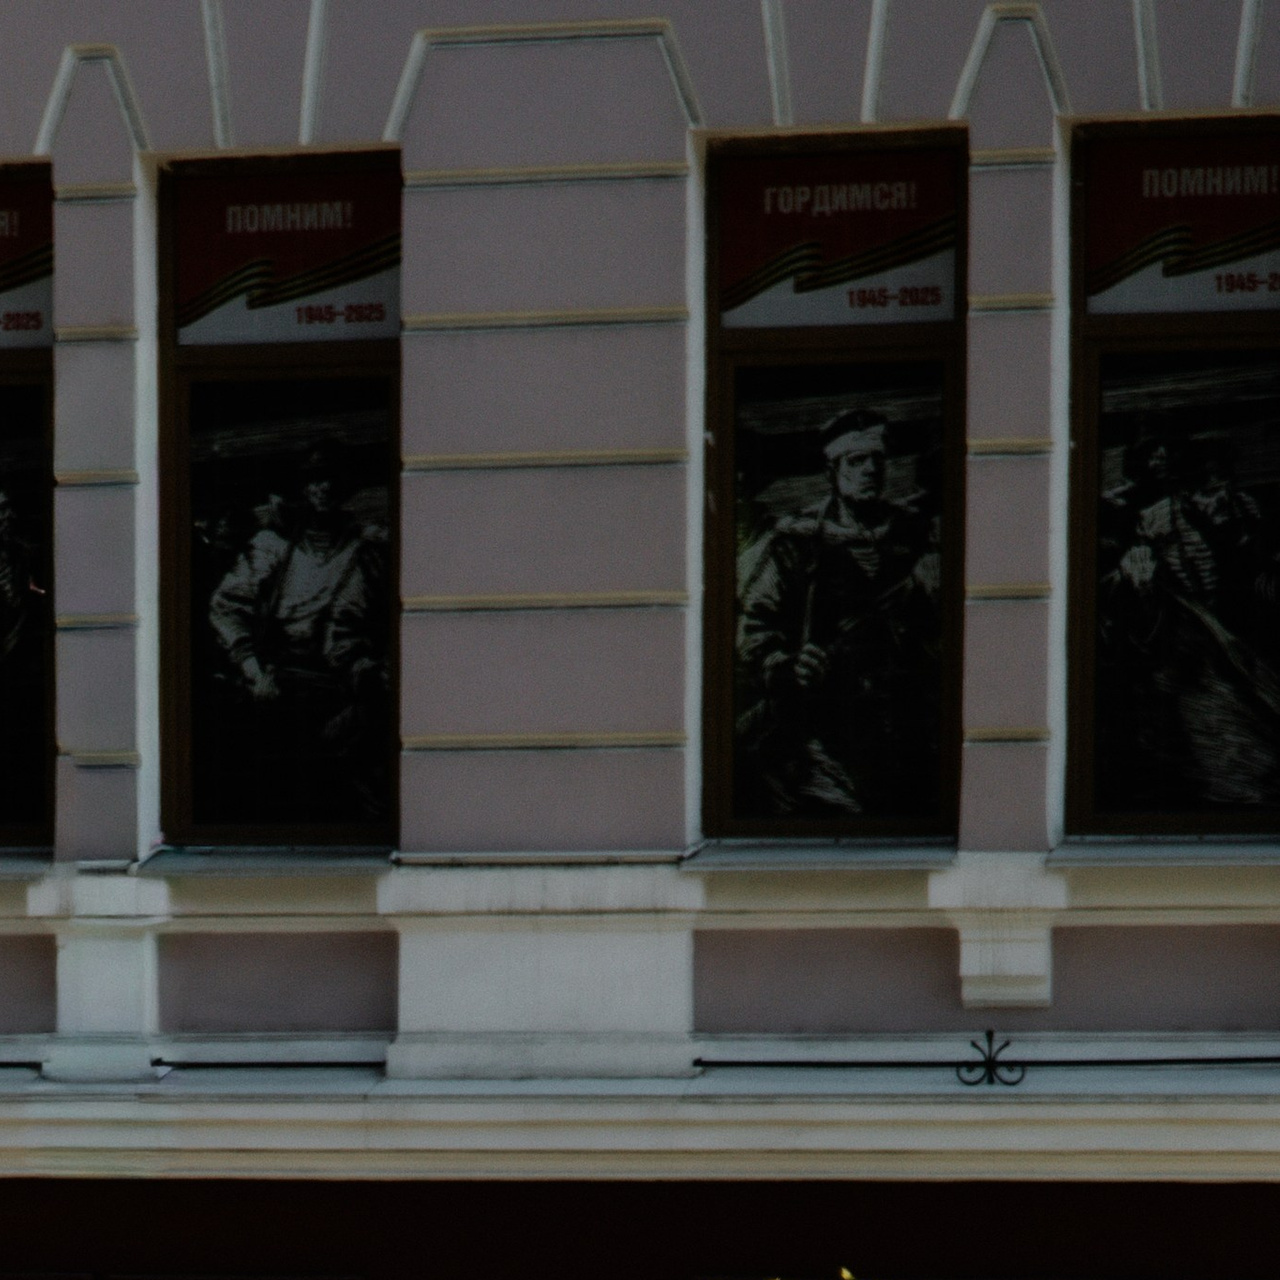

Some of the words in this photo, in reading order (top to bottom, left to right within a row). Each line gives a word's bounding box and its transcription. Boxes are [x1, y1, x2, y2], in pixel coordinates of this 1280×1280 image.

[1142, 165, 1279, 198] ПОМНИМ!
[764, 183, 917, 217] ГОРДИМСЯ!
[226, 202, 352, 234] ПОМНИМ!
[1215, 272, 1280, 294] 1945-2
[848, 287, 941, 309] 1945-2025
[296, 304, 384, 324] 1945-2025
